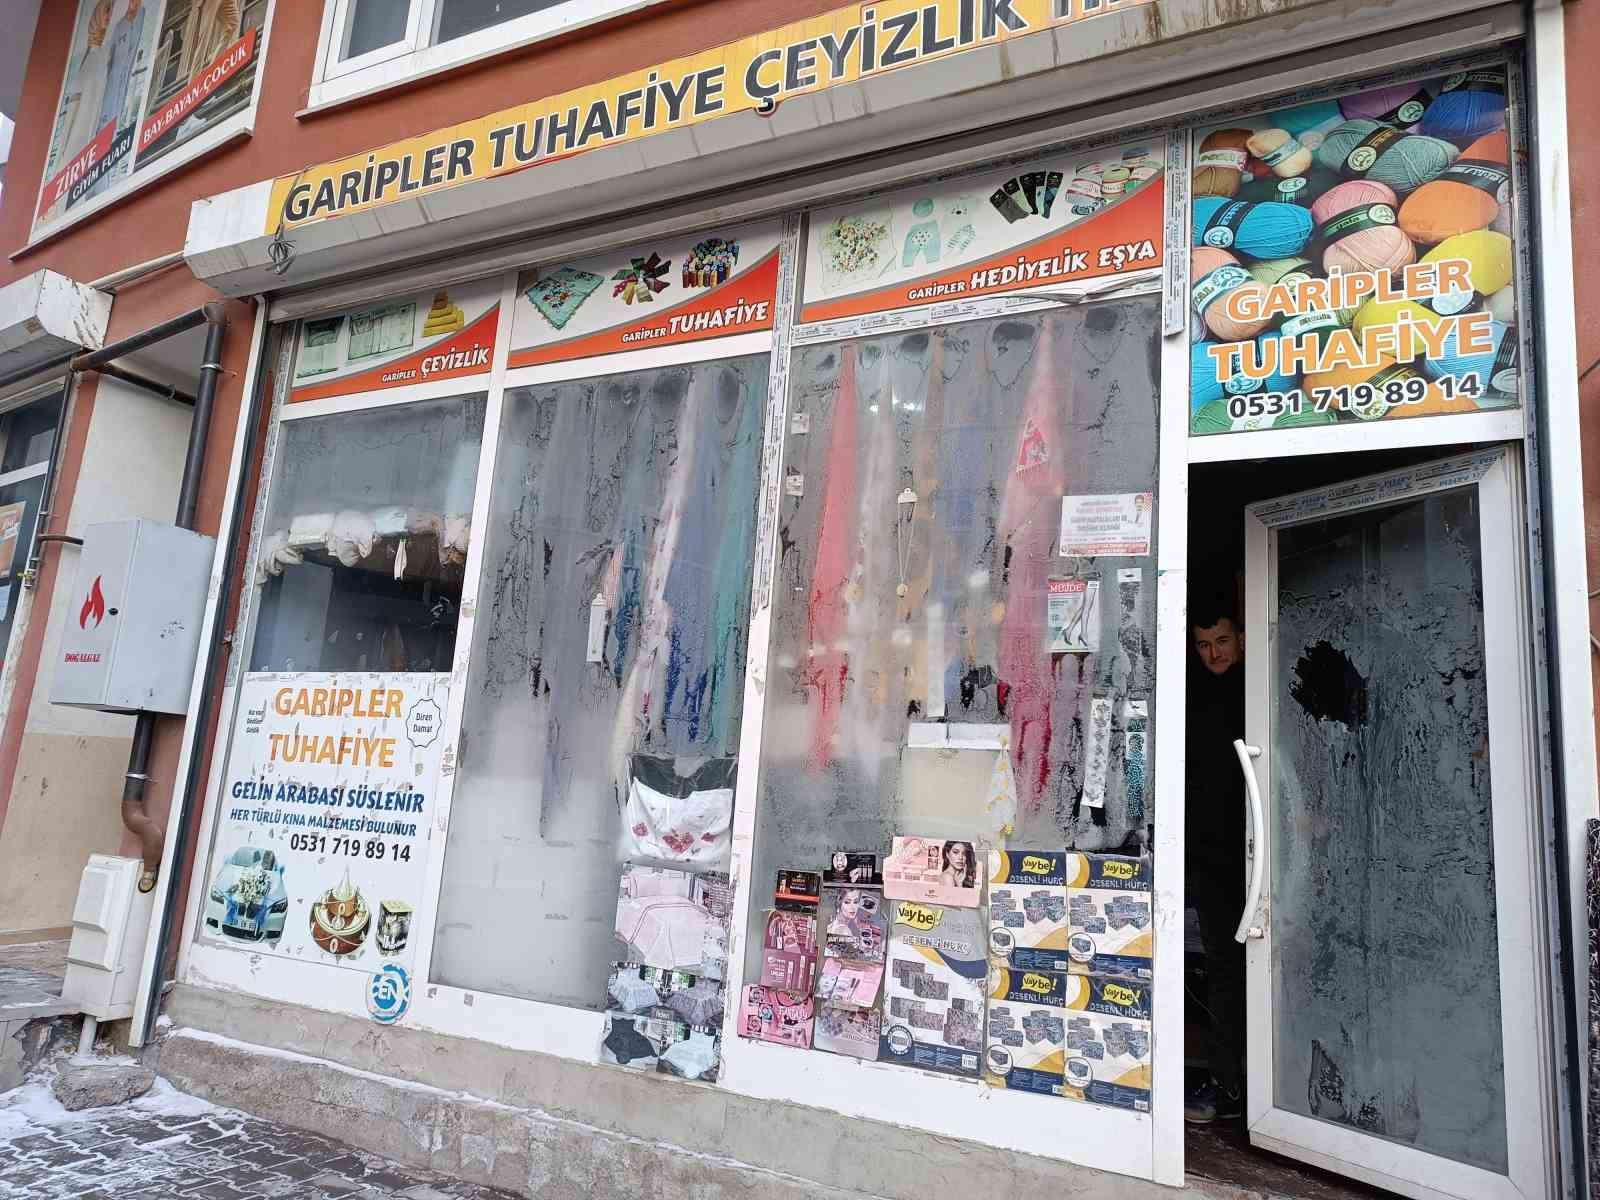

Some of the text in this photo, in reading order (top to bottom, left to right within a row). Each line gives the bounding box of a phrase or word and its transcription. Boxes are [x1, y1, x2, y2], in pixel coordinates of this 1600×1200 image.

[285, 139, 475, 222] GARİPLER
[489, 65, 726, 169] TUHAFİYE
[908, 239, 1158, 301] GARİPLER HEDİYELİK EŞYA
[1226, 257, 1473, 323] GARİPLER
[622, 326, 668, 344] GARİPLER
[669, 298, 770, 335] TUHAFİYE
[420, 344, 489, 380] ÇEYİZLİK
[1207, 311, 1494, 383] TUHAFİYE
[1228, 374, 1481, 419] 0531 719 89 14
[274, 680, 404, 718] GARİPLER
[270, 729, 397, 768] TUHAFİYE
[232, 776, 425, 813] GELİN ARABASI SÜSLENİR
[230, 808, 417, 837] HER TÜRLÜ KINA MALZEMESİ BULUNUR
[290, 833, 411, 862] 0531 719 89 14
